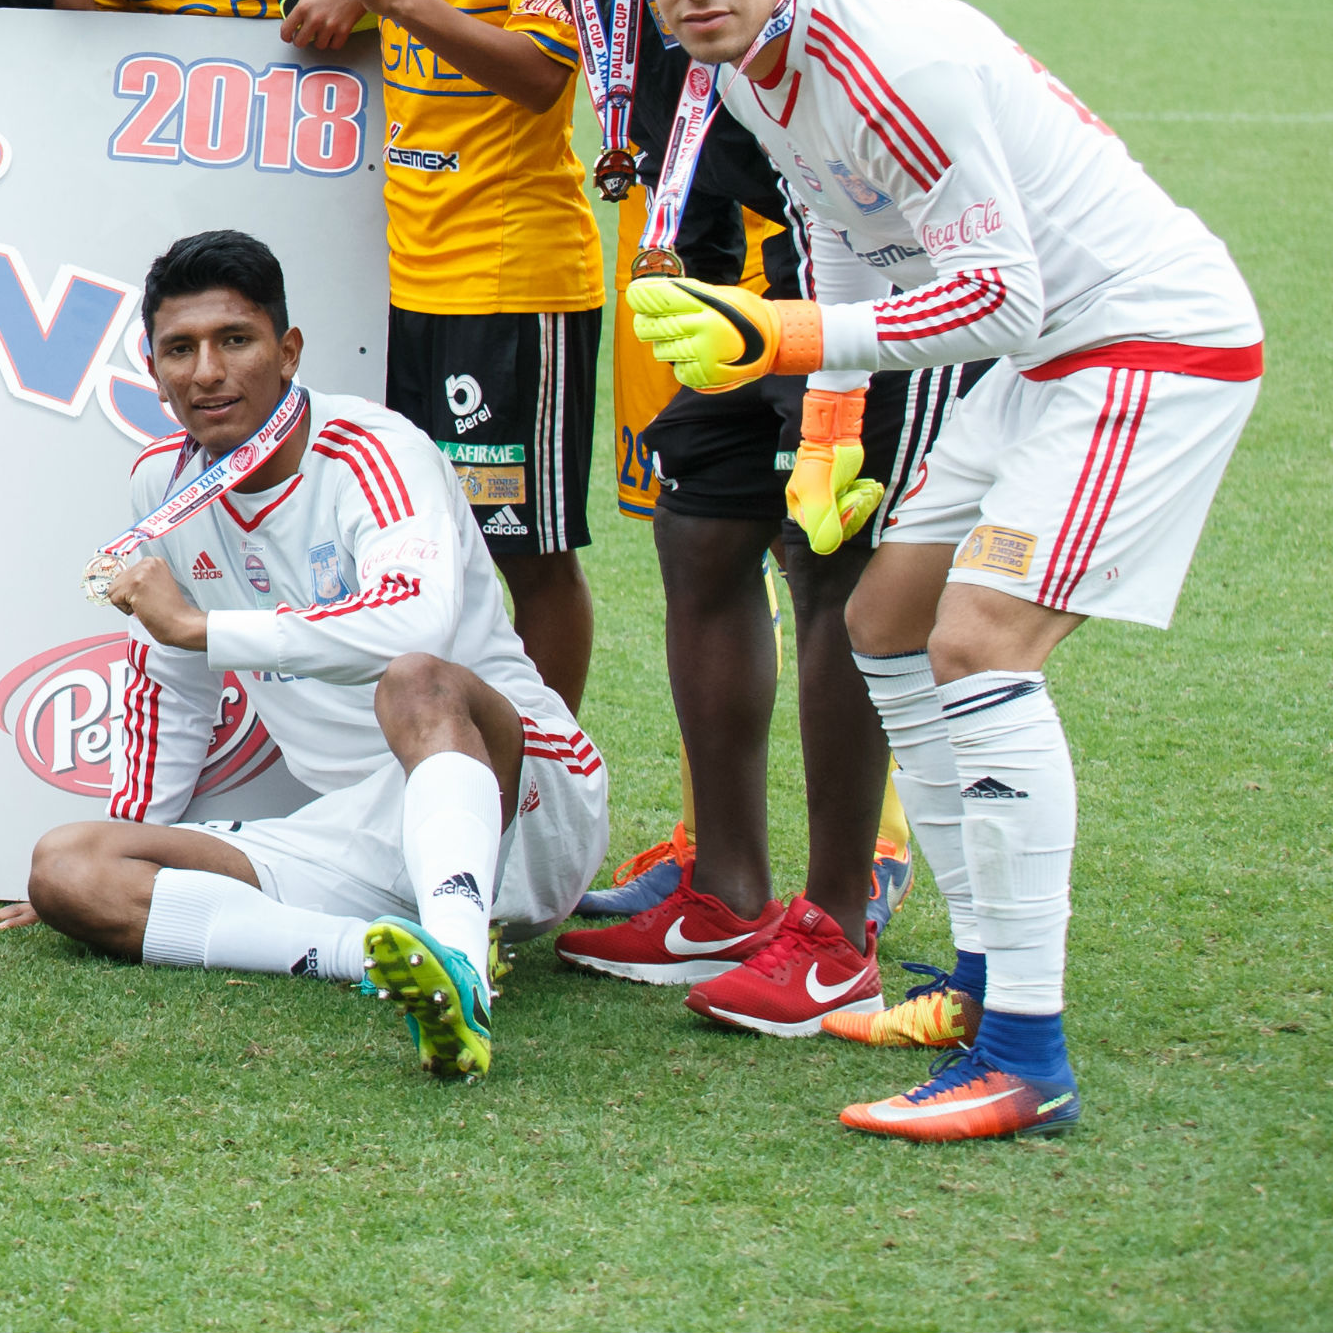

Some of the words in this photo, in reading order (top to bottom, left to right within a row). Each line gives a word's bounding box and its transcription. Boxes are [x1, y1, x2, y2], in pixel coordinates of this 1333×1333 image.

[614, 3, 627, 30] CUP
[589, 23, 603, 49] CUP
[611, 31, 624, 79] DALLAS
[109, 53, 366, 177] 2018
[388, 148, 459, 171] CEMEX
[257, 406, 286, 445] DALLAS
[455, 404, 493, 435] Berel
[454, 445, 515, 463] AFIRME
[146, 498, 180, 529] DALLAS
[177, 485, 201, 508] CUP
[196, 465, 228, 491] XXXIX
[483, 524, 529, 536] adidas
